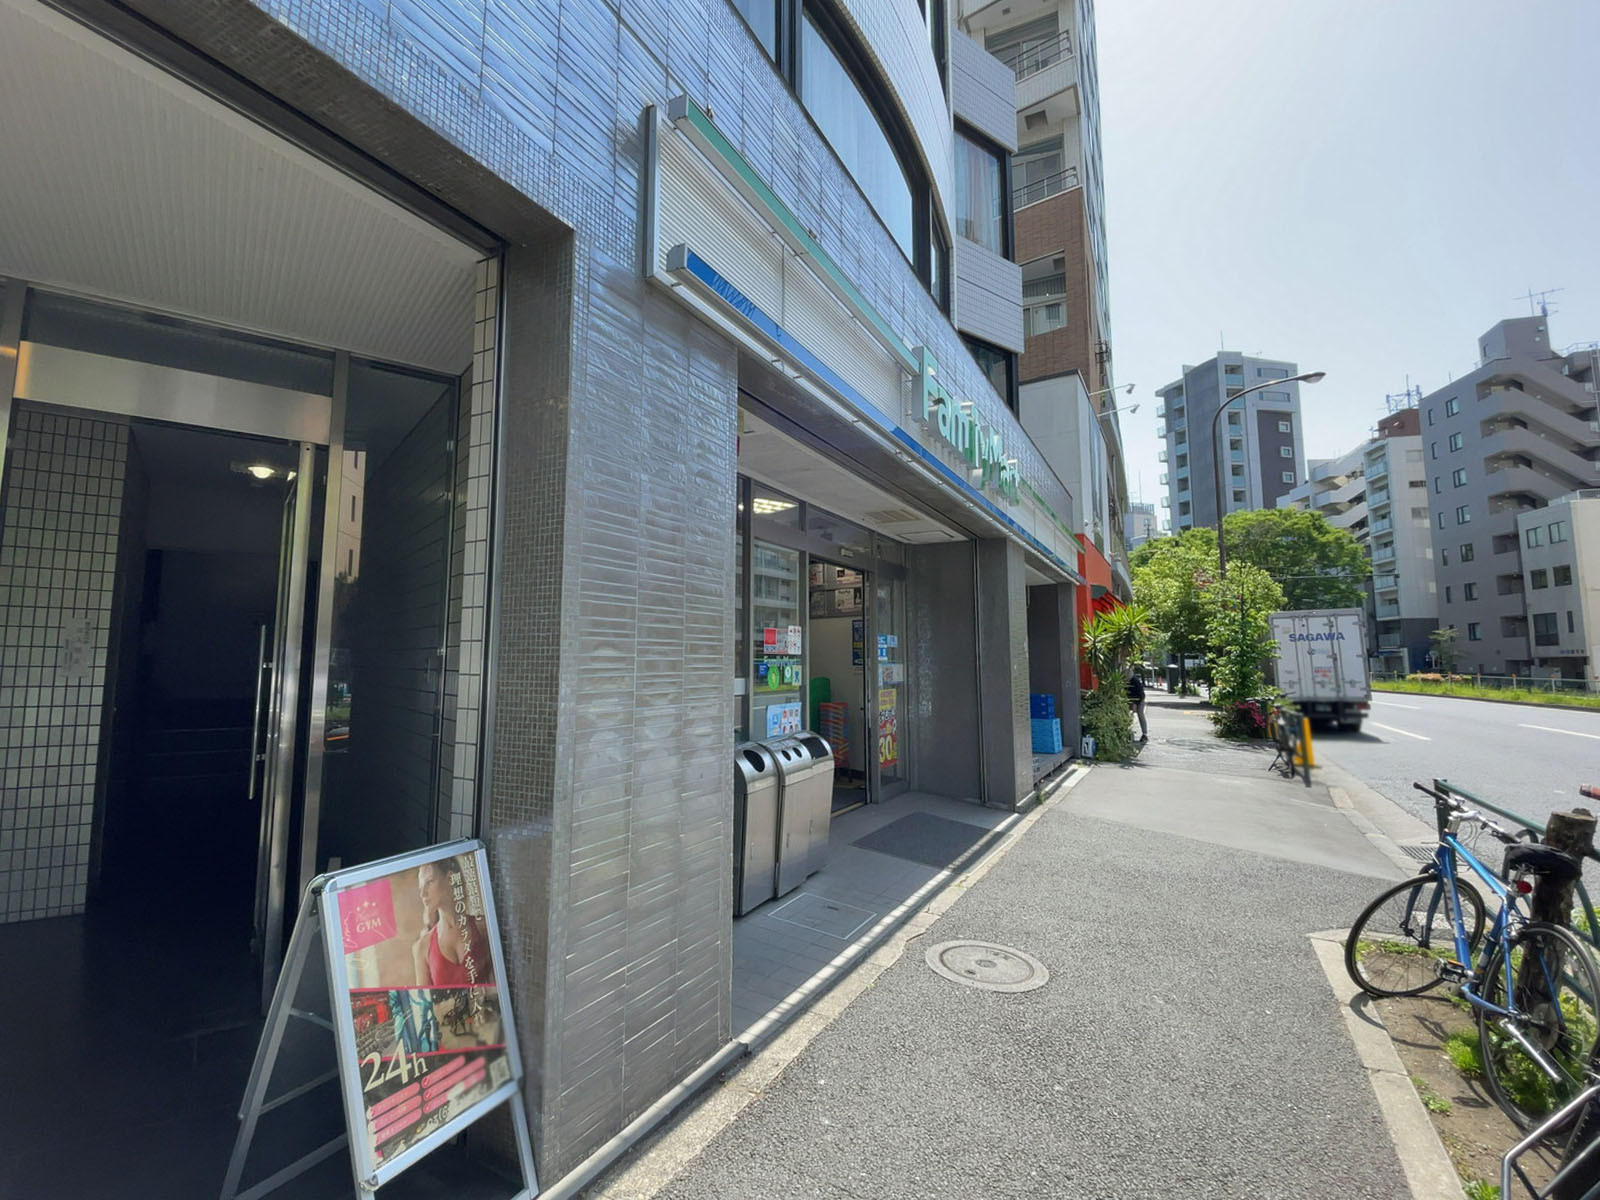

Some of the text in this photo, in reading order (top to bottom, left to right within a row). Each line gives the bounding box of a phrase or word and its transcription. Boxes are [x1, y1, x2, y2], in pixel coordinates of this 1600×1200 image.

[915, 346, 1020, 503] FamilyMart
[1288, 631, 1345, 642] SAGAWA
[356, 917, 382, 933] GYM
[360, 1039, 428, 1094] 24h
